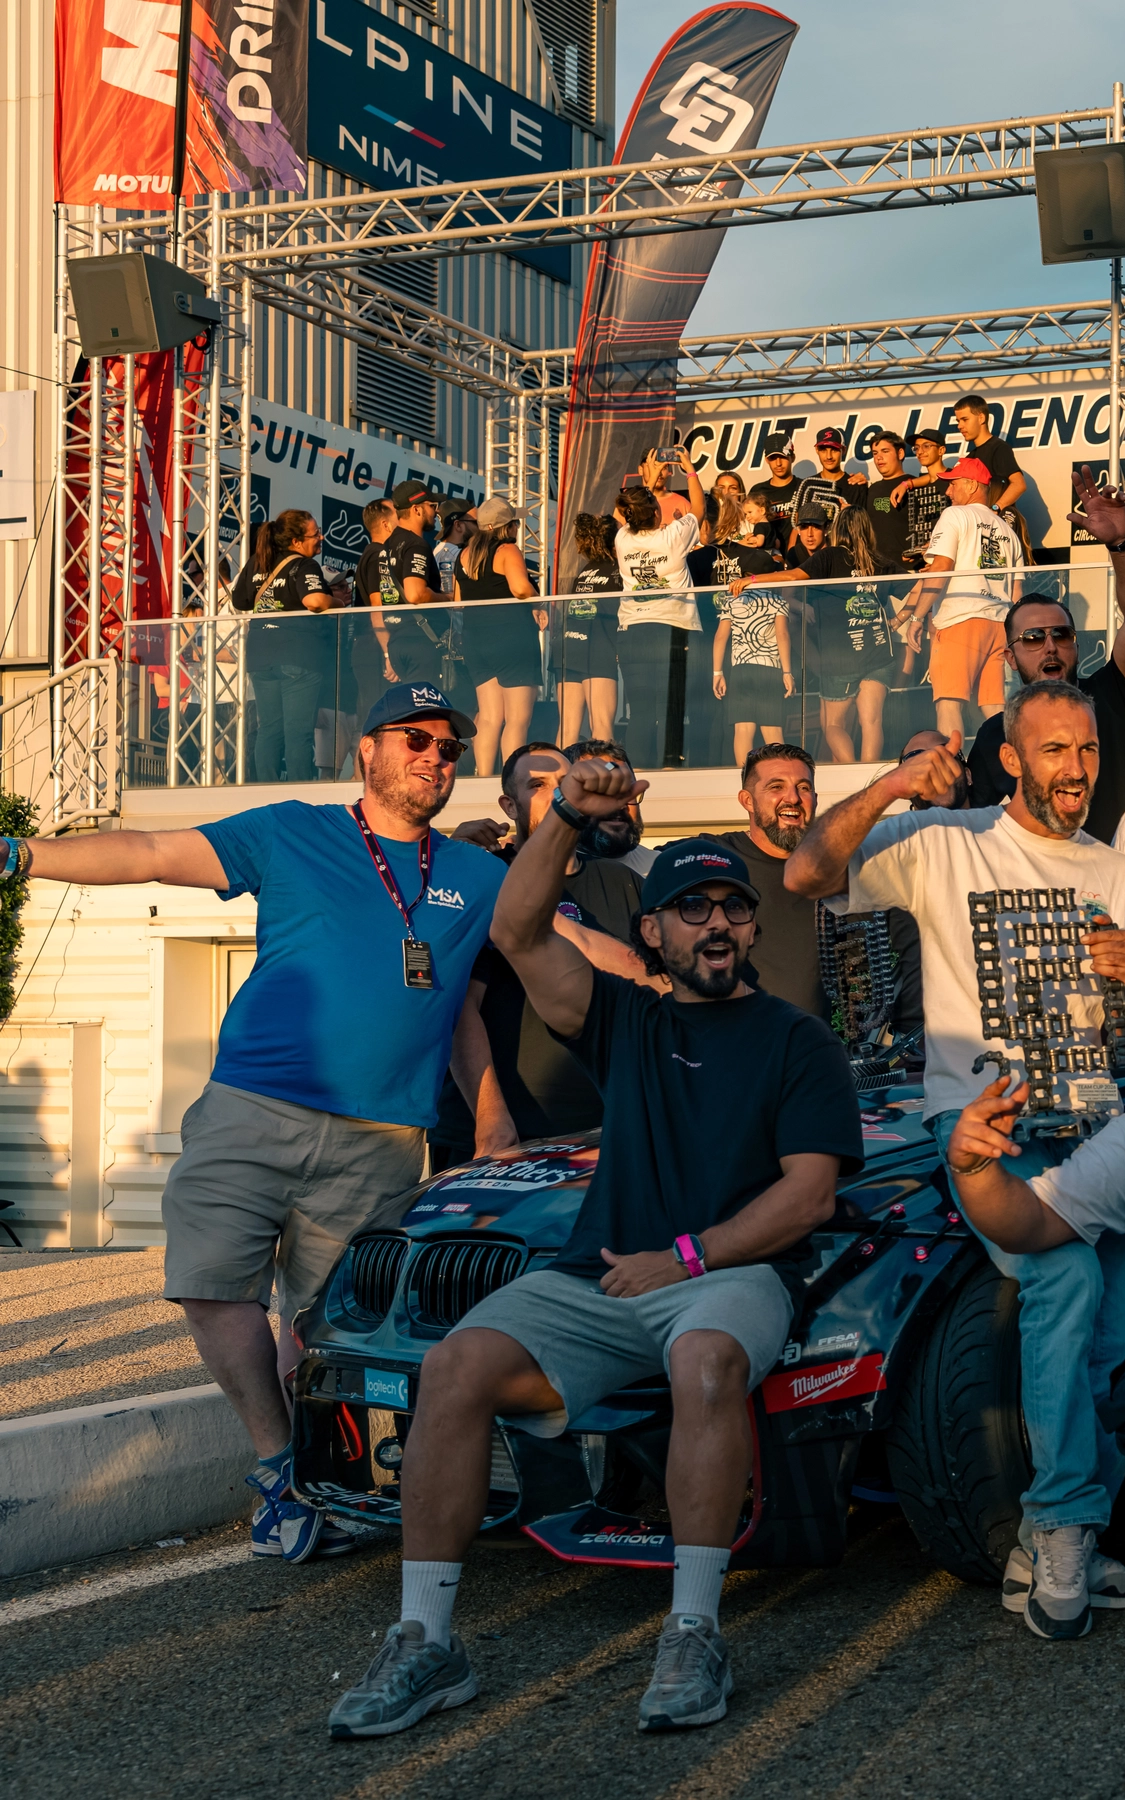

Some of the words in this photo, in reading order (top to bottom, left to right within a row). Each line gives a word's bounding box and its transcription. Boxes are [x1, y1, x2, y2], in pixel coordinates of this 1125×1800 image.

[673, 416, 808, 472] CUIT
[332, 447, 373, 491] de
[427, 886, 465, 906] MSA
[457, 1180, 512, 1188] CUSTOM
[835, 1340, 859, 1350] DRIFT
[366, 1377, 397, 1397] logitech
[788, 1363, 857, 1399] Milwaukee
